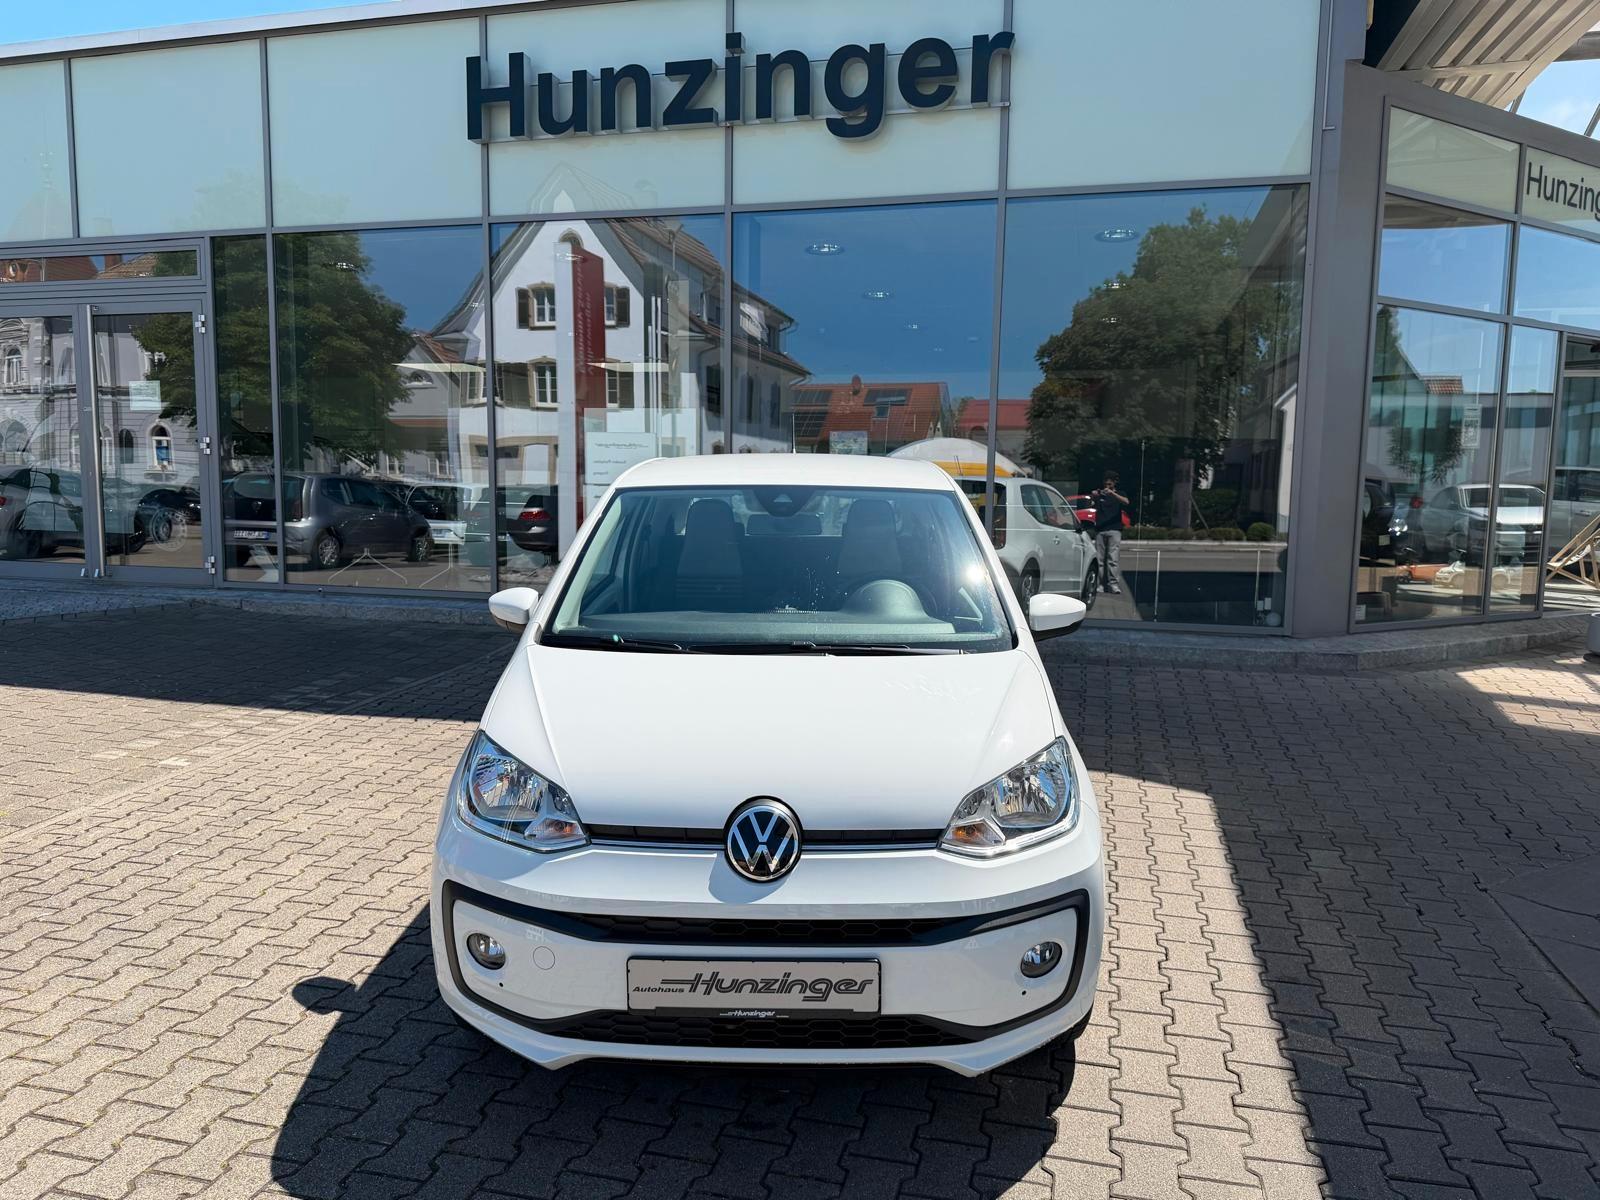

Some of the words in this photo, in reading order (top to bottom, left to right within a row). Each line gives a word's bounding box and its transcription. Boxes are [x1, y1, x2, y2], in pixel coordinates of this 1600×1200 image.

[466, 31, 1016, 141] Hunzinger
[660, 971, 874, 1002] Hunzinger
[720, 1009, 776, 1018] Hunzinger
